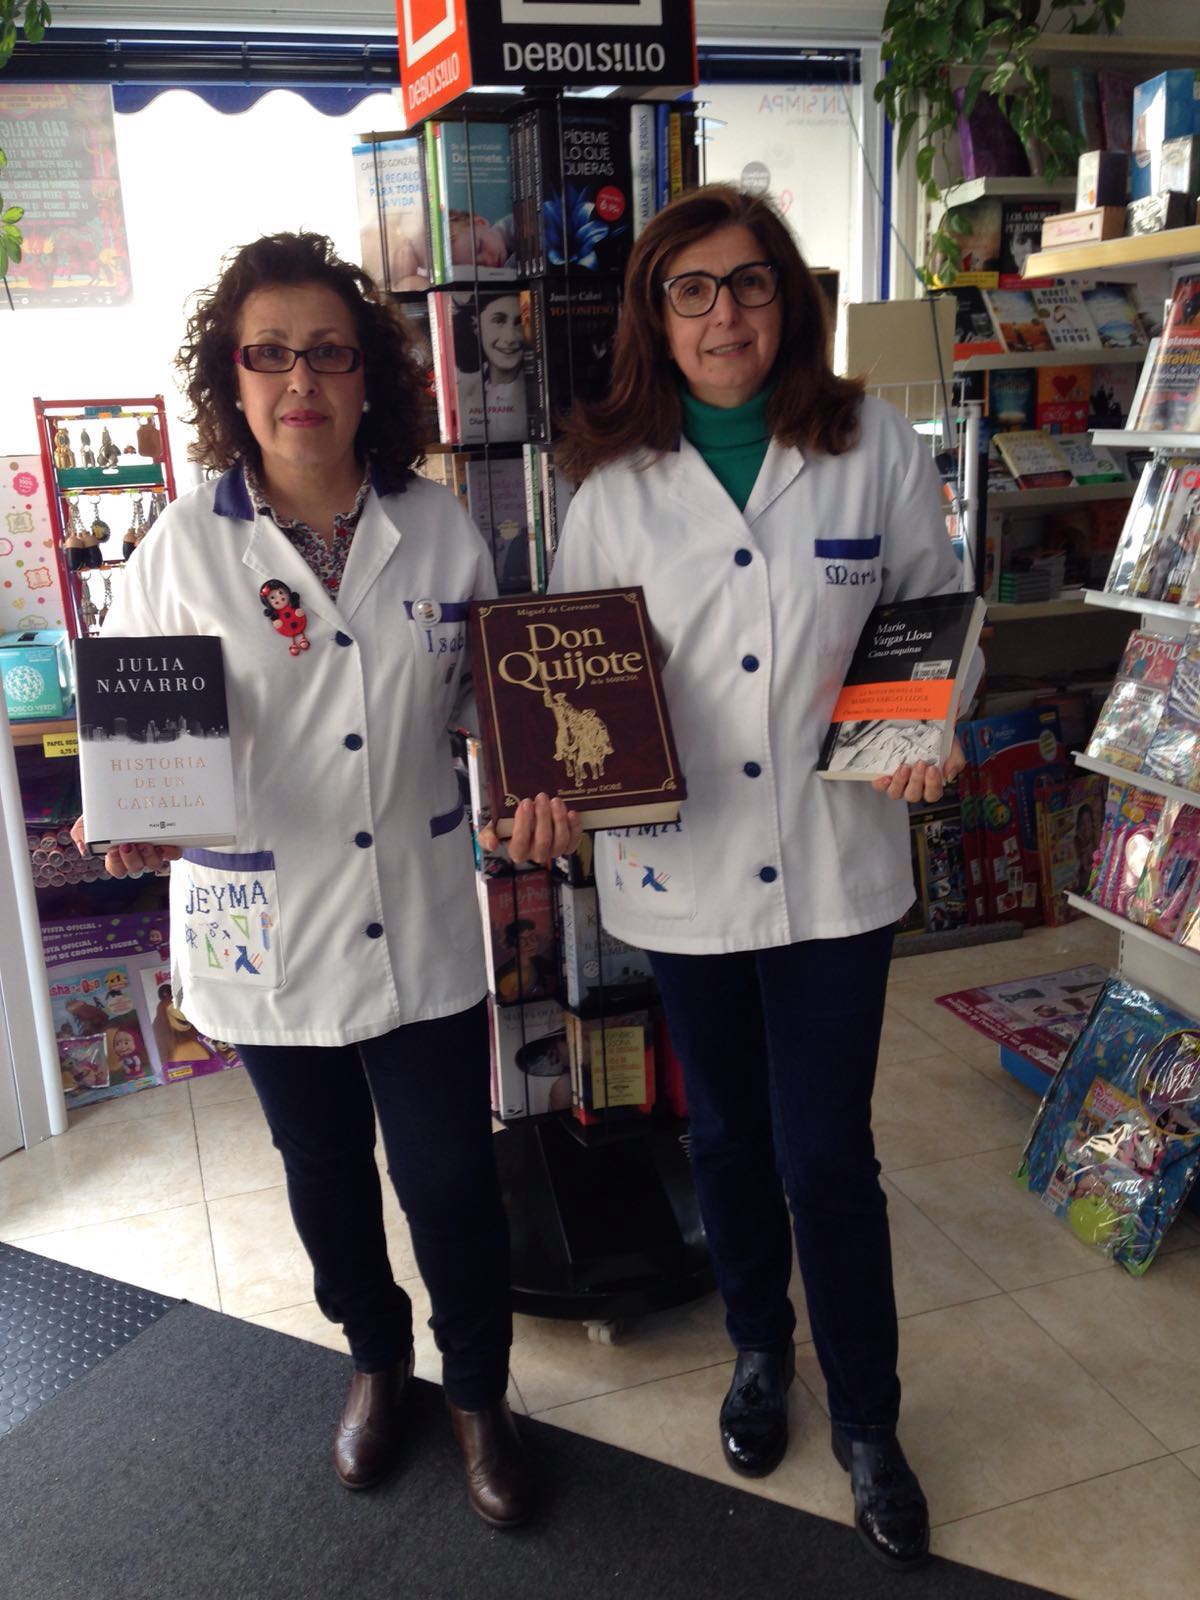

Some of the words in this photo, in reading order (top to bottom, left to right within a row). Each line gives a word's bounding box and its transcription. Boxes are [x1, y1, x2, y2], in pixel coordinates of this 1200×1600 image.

[583, 146, 610, 161] QUE
[517, 607, 546, 617] Miguel
[547, 605, 558, 614] de
[559, 603, 601, 613] Cervantes
[877, 622, 906, 635] Mario
[525, 623, 607, 653] Don
[873, 634, 904, 647] Vargas
[905, 630, 933, 643] Llosa
[867, 649, 890, 659] Cinco
[890, 645, 923, 657] esquinas
[116, 657, 185, 673] JULIA
[498, 650, 644, 692] Quijote
[96, 676, 206, 694] NAVARRO
[111, 756, 207, 772] HISTORIA
[135, 777, 157, 789] DE
[164, 775, 186, 787] UN
[117, 795, 206, 811] CANALLA
[185, 879, 269, 915] JEYMA
[66, 922, 97, 932] OFICIAL
[59, 951, 70, 959] DE
[71, 945, 104, 957] CROMOS
[110, 939, 139, 950] FIGURA
[61, 939, 92, 951] OFICIAL
[80, 977, 101, 994] Oso
